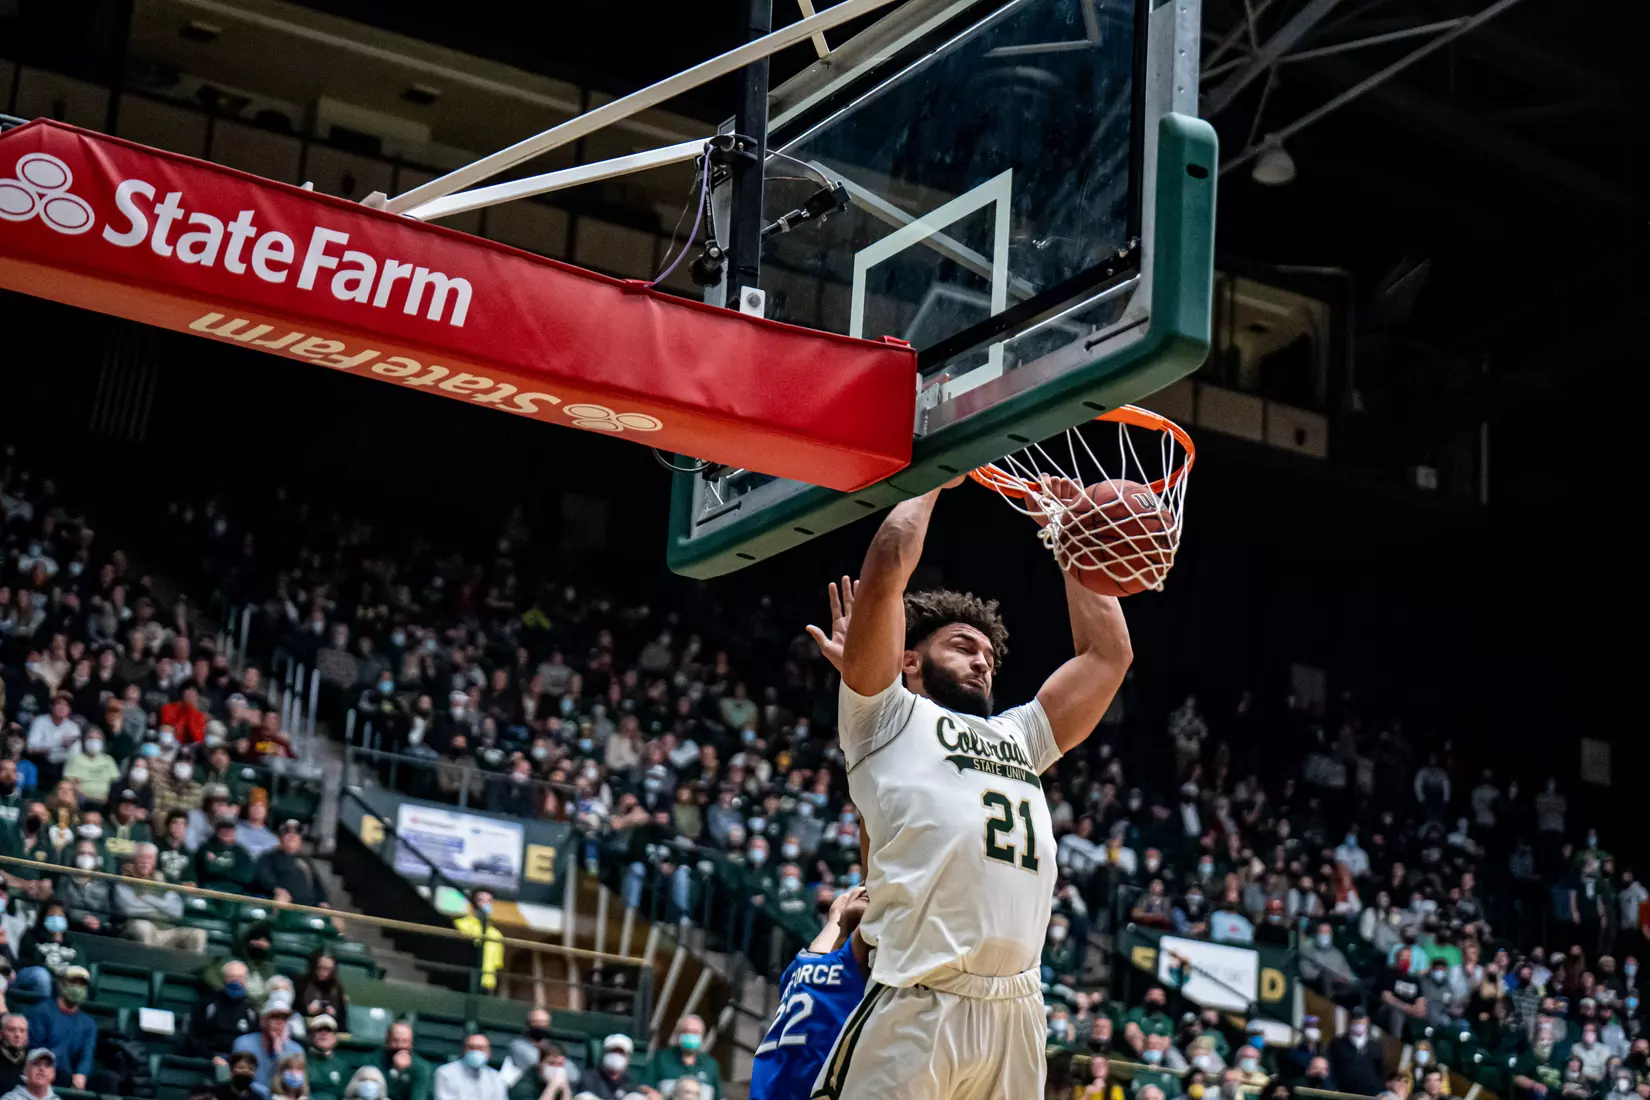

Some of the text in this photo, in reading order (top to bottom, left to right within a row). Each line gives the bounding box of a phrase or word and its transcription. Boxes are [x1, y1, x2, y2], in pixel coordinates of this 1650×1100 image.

[973, 758, 1026, 782] STATE UNIV
[981, 788, 1040, 876] 21
[525, 843, 556, 884] E
[791, 964, 843, 988] ORCE
[1260, 967, 1286, 1003] D
